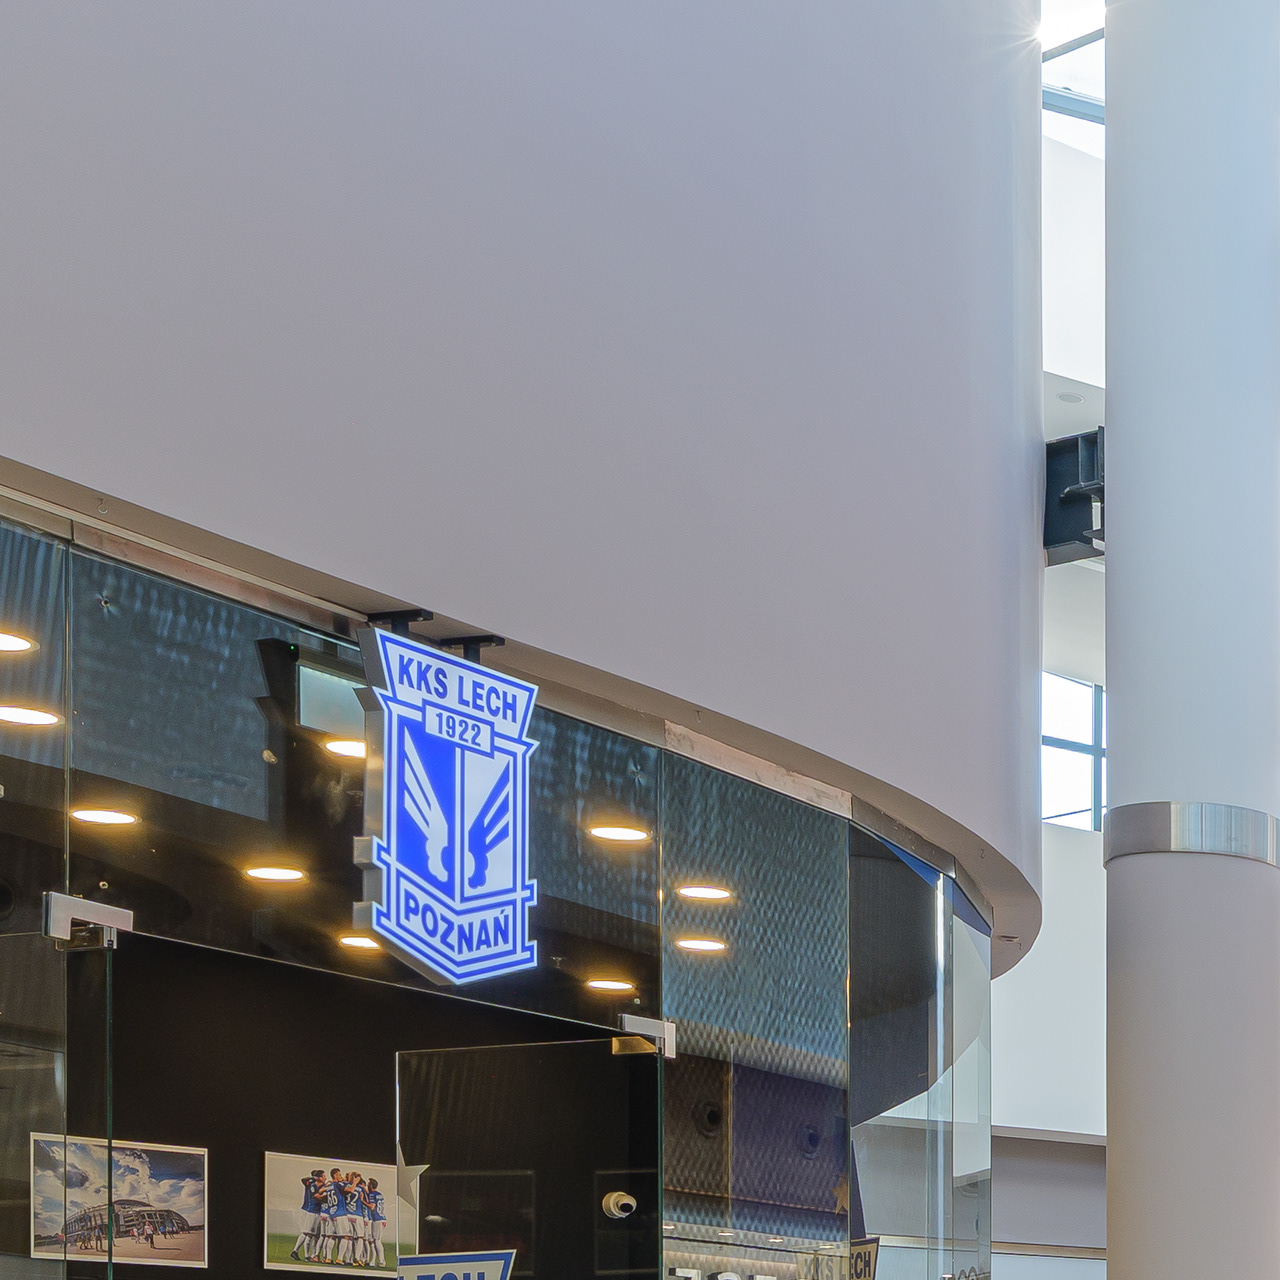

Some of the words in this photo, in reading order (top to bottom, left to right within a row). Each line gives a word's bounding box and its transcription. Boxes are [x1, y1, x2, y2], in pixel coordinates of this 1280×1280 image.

[398, 653, 448, 700] KKS
[457, 674, 517, 724] LECH
[435, 711, 482, 748] 1922
[404, 888, 510, 956] POZNAŃ
